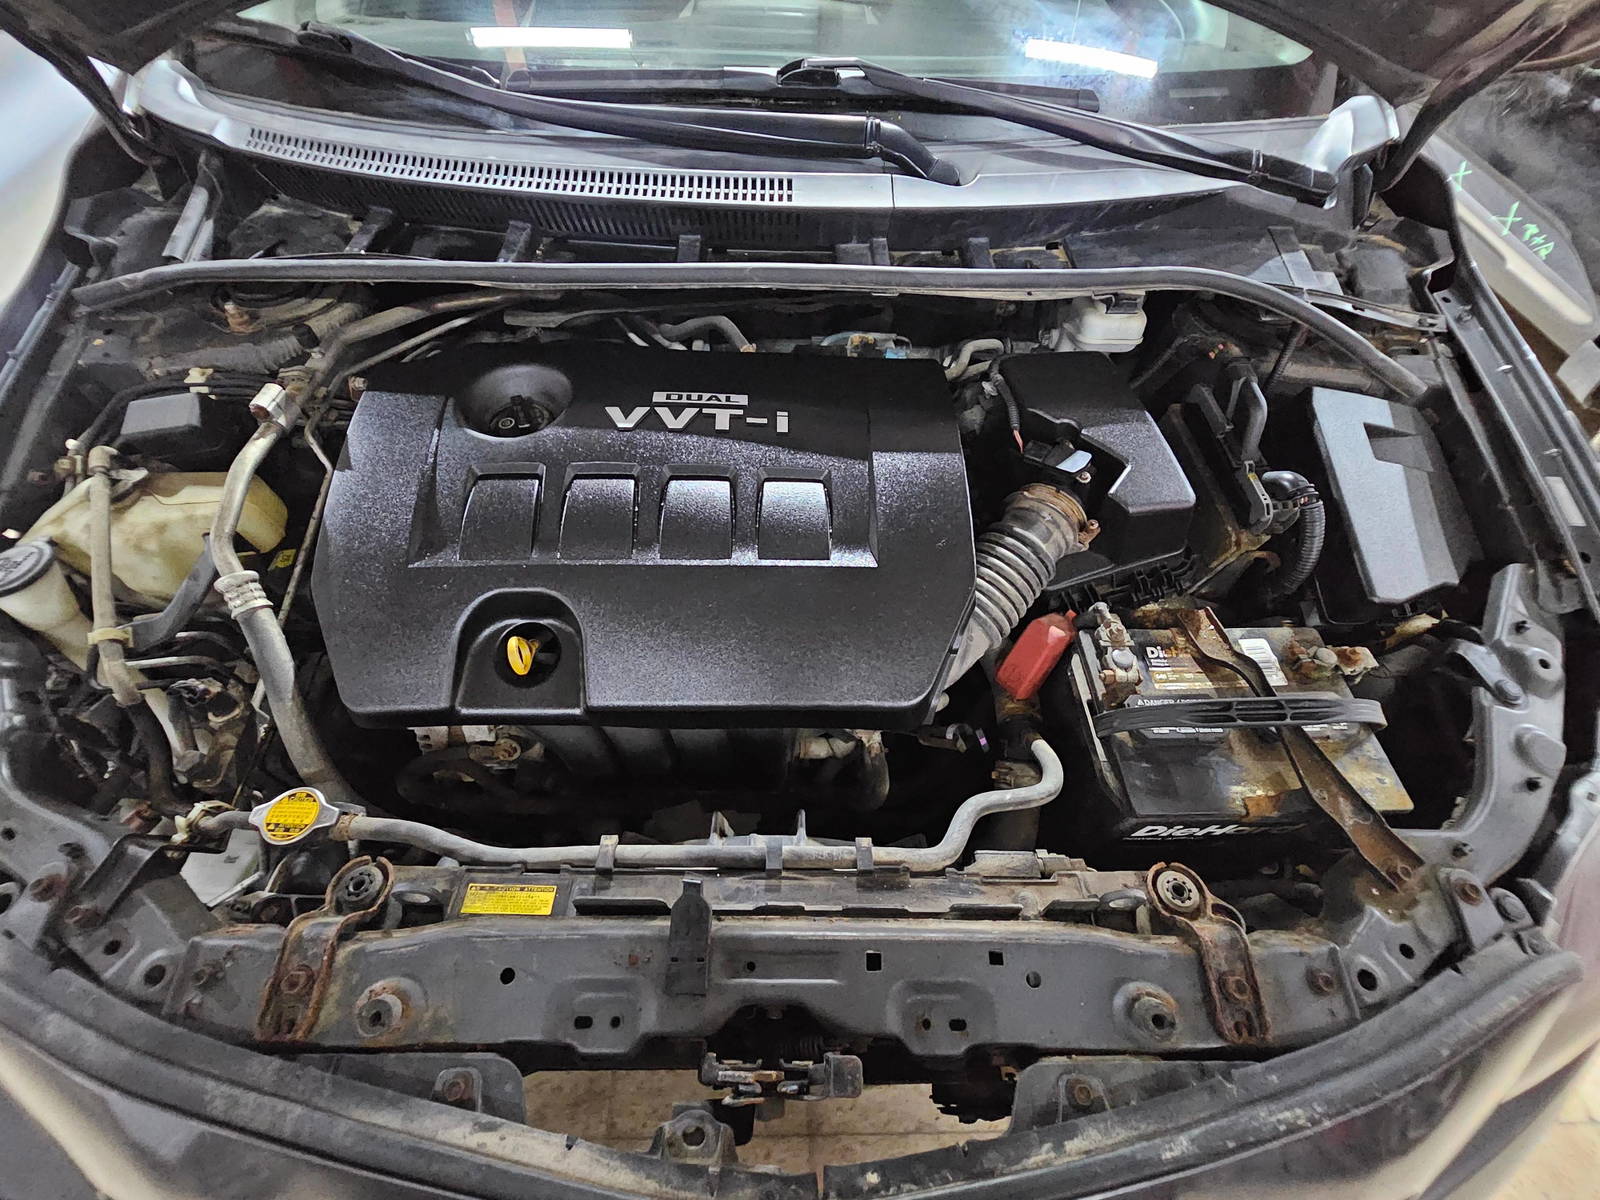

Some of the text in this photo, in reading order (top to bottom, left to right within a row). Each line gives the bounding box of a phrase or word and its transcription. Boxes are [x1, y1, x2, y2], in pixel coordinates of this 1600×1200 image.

[665, 393, 740, 403] DUAL
[604, 406, 789, 433] VVT-i
[1130, 823, 1308, 838] DieHard
